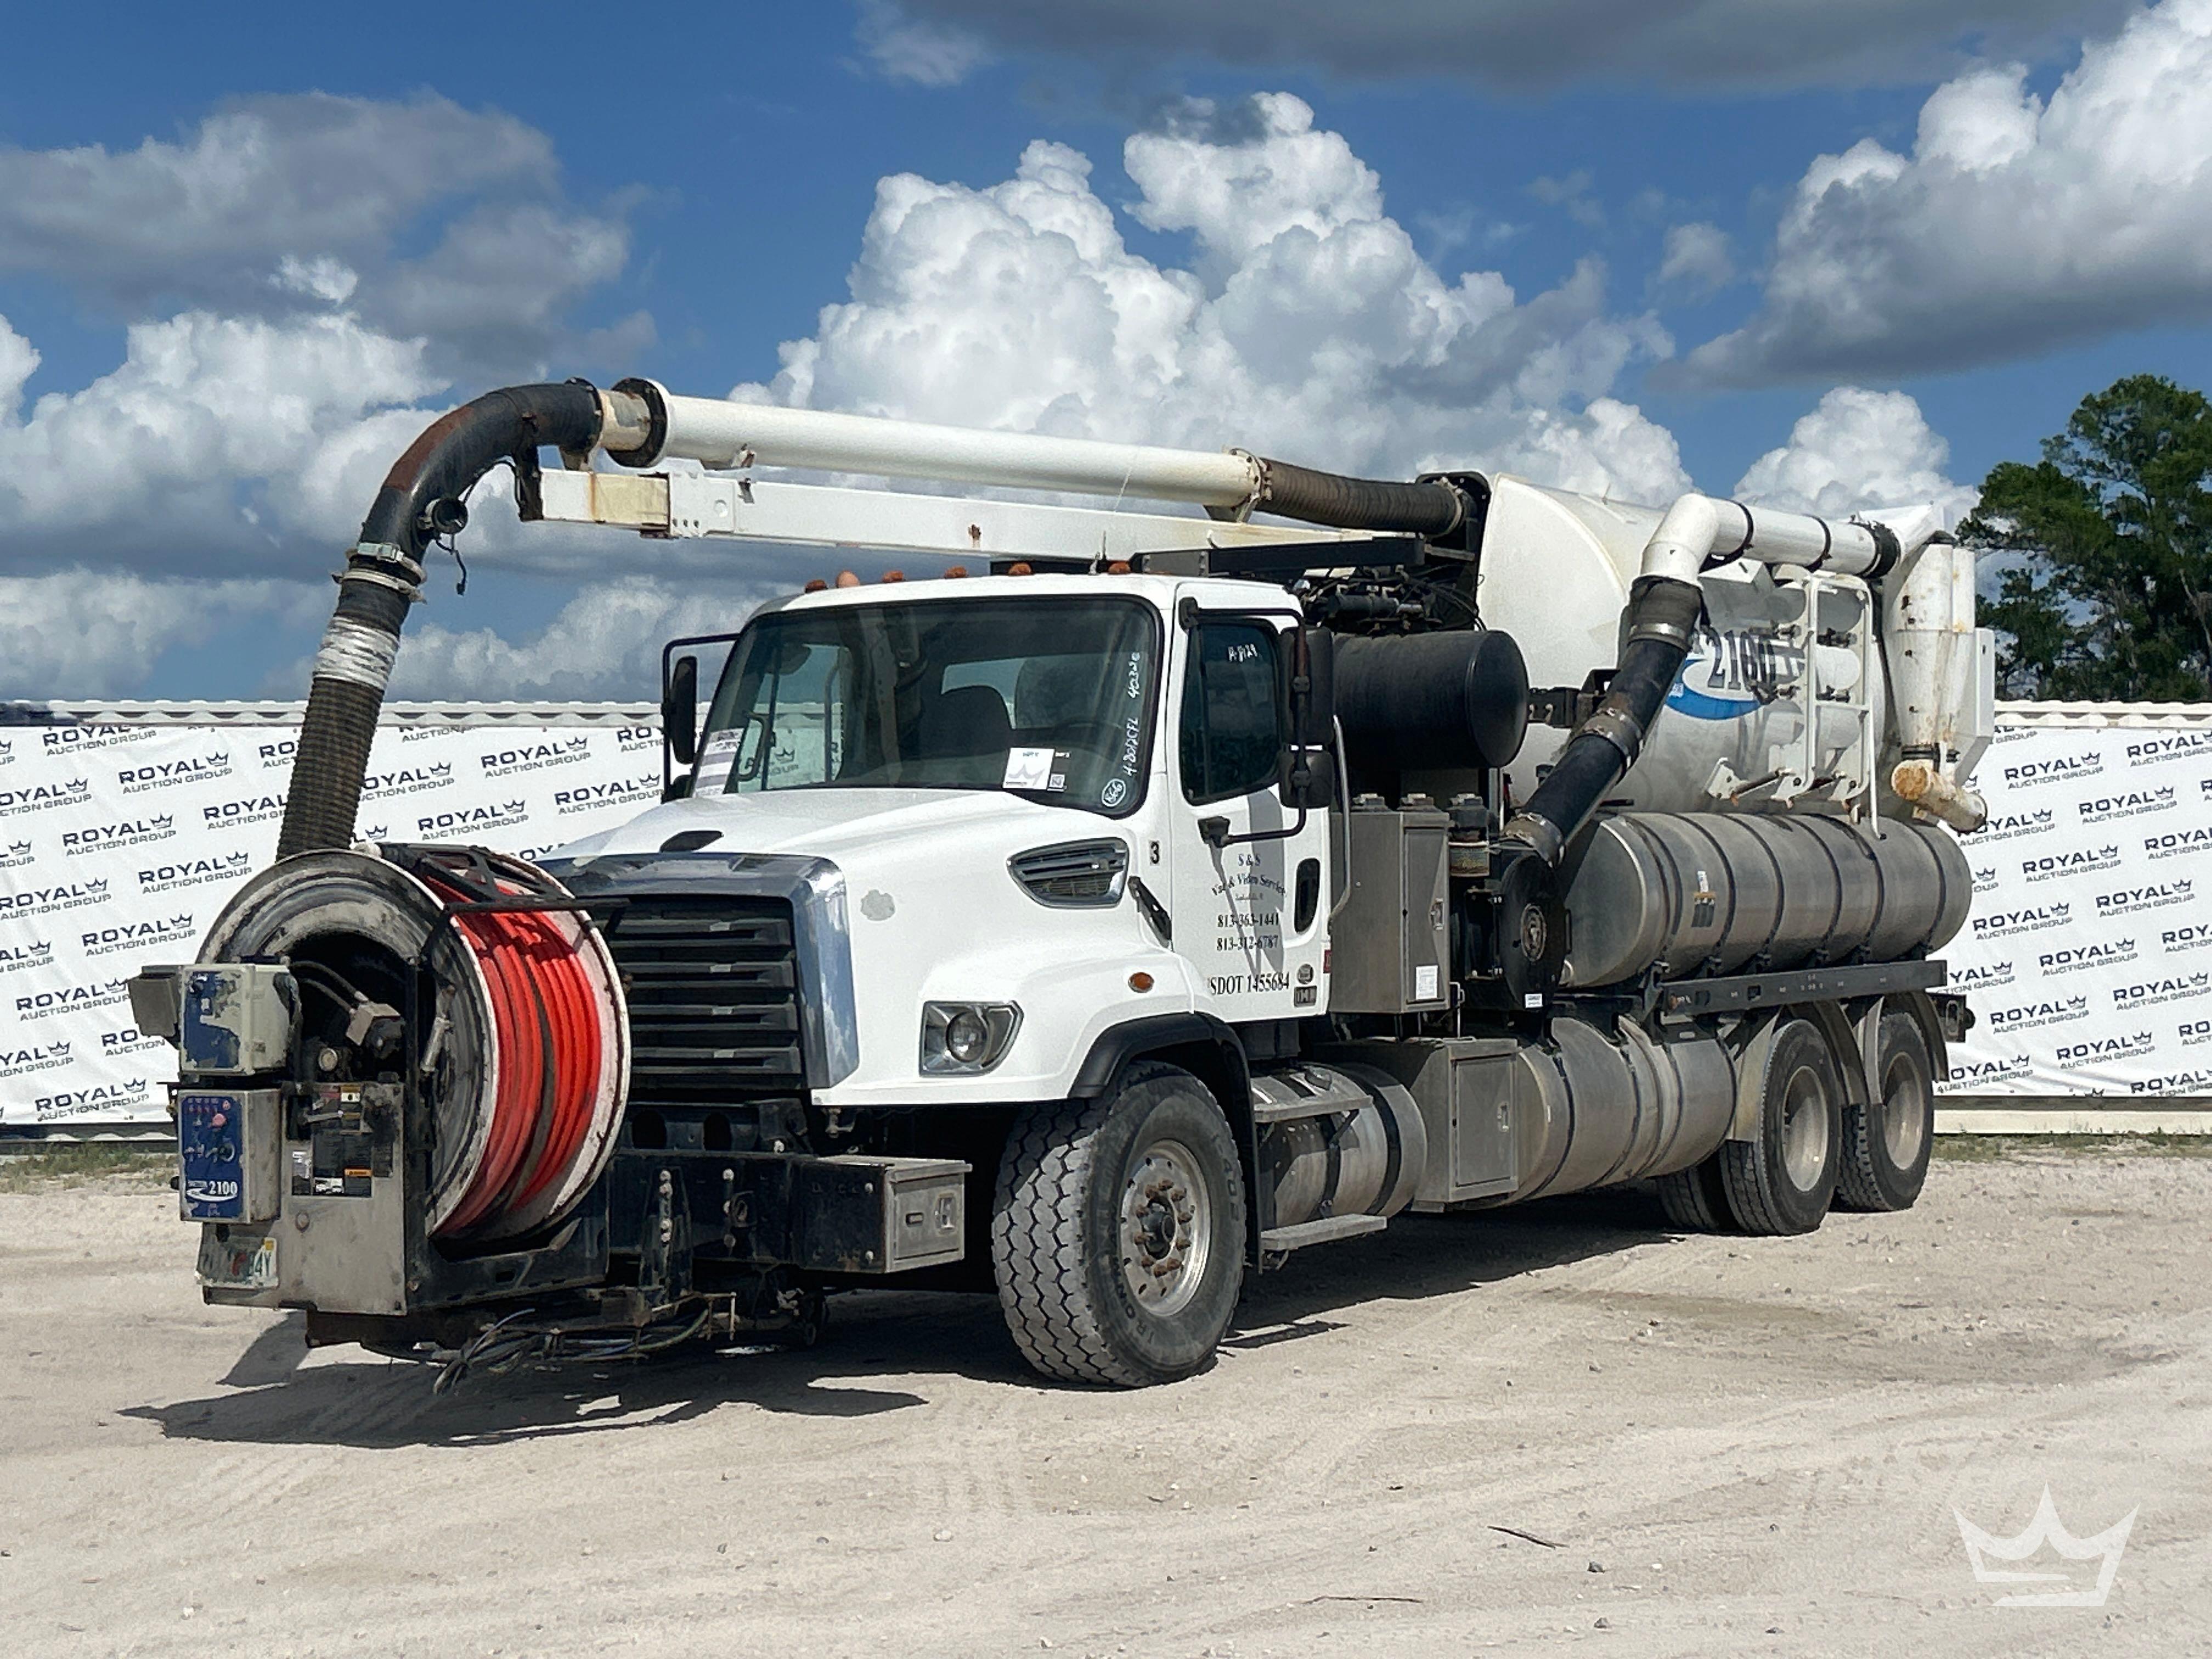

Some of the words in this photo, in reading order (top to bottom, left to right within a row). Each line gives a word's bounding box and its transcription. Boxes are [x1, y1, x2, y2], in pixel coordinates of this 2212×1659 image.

[42, 725, 131, 747] ROYAL
[46, 740, 107, 756] AUCTION
[110, 730, 157, 745] GROUP
[620, 738, 664, 753] AUCTI
[2126, 735, 2204, 758] ROYAL
[481, 742, 567, 768] ROYAL
[485, 761, 543, 778] AUCTION
[545, 752, 591, 767] GROUP
[119, 759, 206, 784] ROYAL
[123, 777, 182, 794] AUCTION
[185, 767, 233, 783] GROUP
[363, 768, 430, 790] OYAL
[2004, 757, 2081, 781] ROYAL
[360, 788, 406, 802] CTION
[408, 777, 455, 793] GROUP
[554, 780, 640, 806] ROYAL
[2008, 774, 2060, 789] AUCTION
[0, 785, 66, 806] OYAL
[0, 804, 42, 817] CTION
[44, 794, 92, 809] GROUP
[203, 794, 287, 820] ROYAL
[558, 798, 617, 815] AUCTION
[618, 789, 664, 804] GROUP
[2079, 791, 2155, 815] ROYAL
[207, 813, 267, 831] AUCTION
[417, 805, 505, 831] ROYAL
[422, 823, 481, 841] AUCTION
[482, 814, 529, 830] GROUP
[2082, 809, 2134, 825] AUCTION
[62, 820, 151, 847] ROYAL
[66, 839, 126, 856] AUCTION
[129, 830, 177, 845] GROUP
[2144, 827, 2212, 850] ROYA
[0, 856, 35, 868] ROUP
[1150, 841, 1160, 865] 3
[1238, 853, 1244, 866] S
[1246, 854, 1254, 867] &
[1255, 853, 1261, 866] S
[2022, 850, 2099, 874] ROYAL
[138, 858, 227, 884] ROYAL
[142, 877, 202, 894] AUCTION
[205, 866, 253, 882] GROUP
[2026, 867, 2078, 883] AUCTION
[0, 884, 86, 911] ROYAL
[1973, 882, 1999, 893] OUP
[2096, 884, 2173, 908] ROYAL
[1, 904, 60, 920] AUCTION
[63, 893, 112, 909] GROUP
[1972, 907, 2050, 932] ROYAL
[81, 921, 171, 947] ROYAL
[86, 939, 146, 957] AUCTION
[149, 928, 196, 945] GROUP
[2162, 924, 2212, 944] ROY
[7, 956, 54, 973] GROUP
[2039, 944, 2116, 967] ROYAL
[1949, 967, 1994, 984] YAL
[2042, 959, 2095, 977] AUCTION
[16, 984, 106, 1011] ROYAL
[1208, 975, 1244, 996] SDOT
[1936, 983, 1972, 994] TION
[2113, 978, 2190, 1002] ROYAL
[20, 1003, 81, 1022] AUCTION
[83, 994, 131, 1009] GROUP
[1990, 1001, 2067, 1025] ROYAL
[2116, 995, 2168, 1011] AUCTION
[1993, 1019, 2046, 1035] AUCTION
[2056, 1036, 2134, 1060] ROYAL
[2182, 1034, 2212, 1046] AUCT
[0, 1047, 48, 1066] YAL
[26, 1056, 74, 1072] GROUP
[2059, 1054, 2113, 1070] AUCTION
[1950, 1060, 2012, 1080] OYAL
[2130, 1070, 2208, 1093] ROYAL
[35, 1085, 124, 1113] ROYAL
[37, 1104, 100, 1122] AUCTION
[101, 1093, 149, 1110] GROUP
[208, 1180, 238, 1195] 2100
